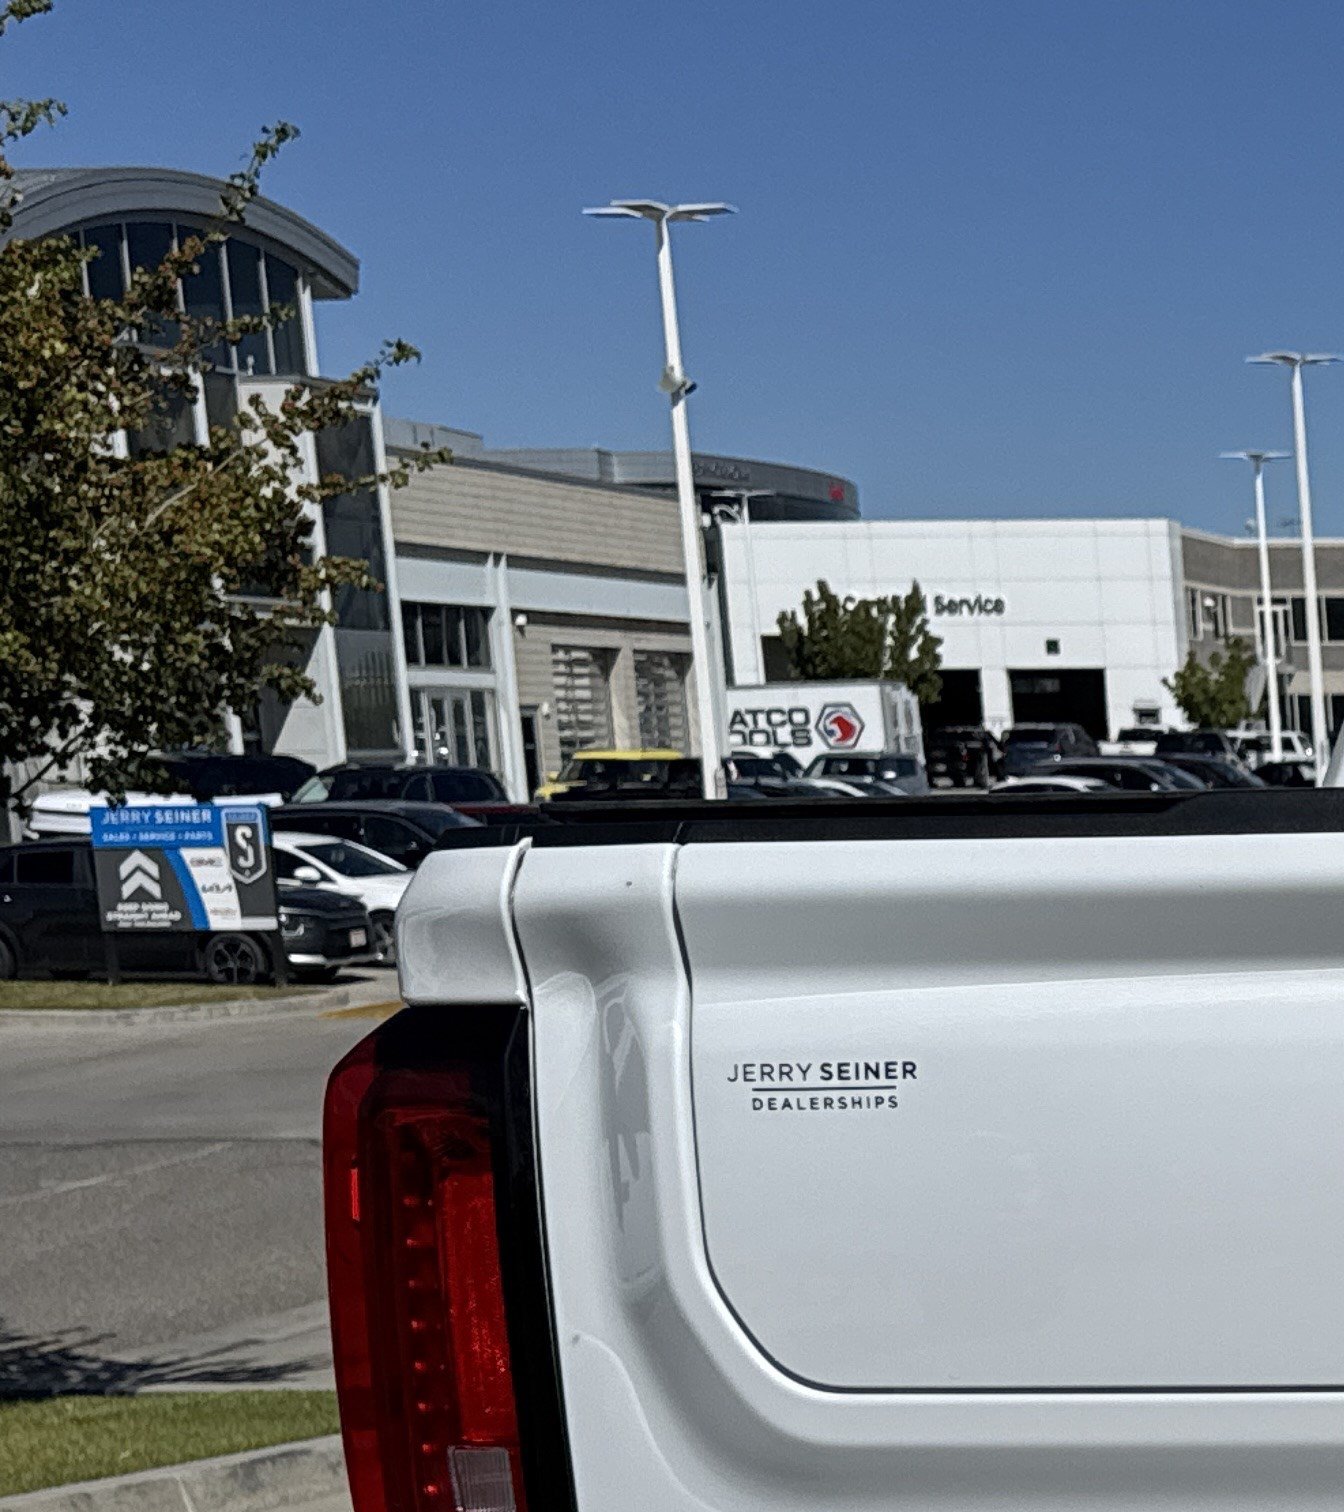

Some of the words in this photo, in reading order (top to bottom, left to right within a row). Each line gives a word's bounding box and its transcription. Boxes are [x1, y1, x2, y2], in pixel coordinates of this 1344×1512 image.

[934, 594, 1005, 616] Service
[728, 706, 810, 729] ATCO
[728, 728, 813, 748] OOLS
[101, 809, 151, 825] JERRY
[154, 808, 212, 824] SEINER
[727, 1063, 812, 1083] JERRY
[819, 1061, 918, 1081] SEINER
[752, 1095, 899, 1111] DEALERSHIPS
